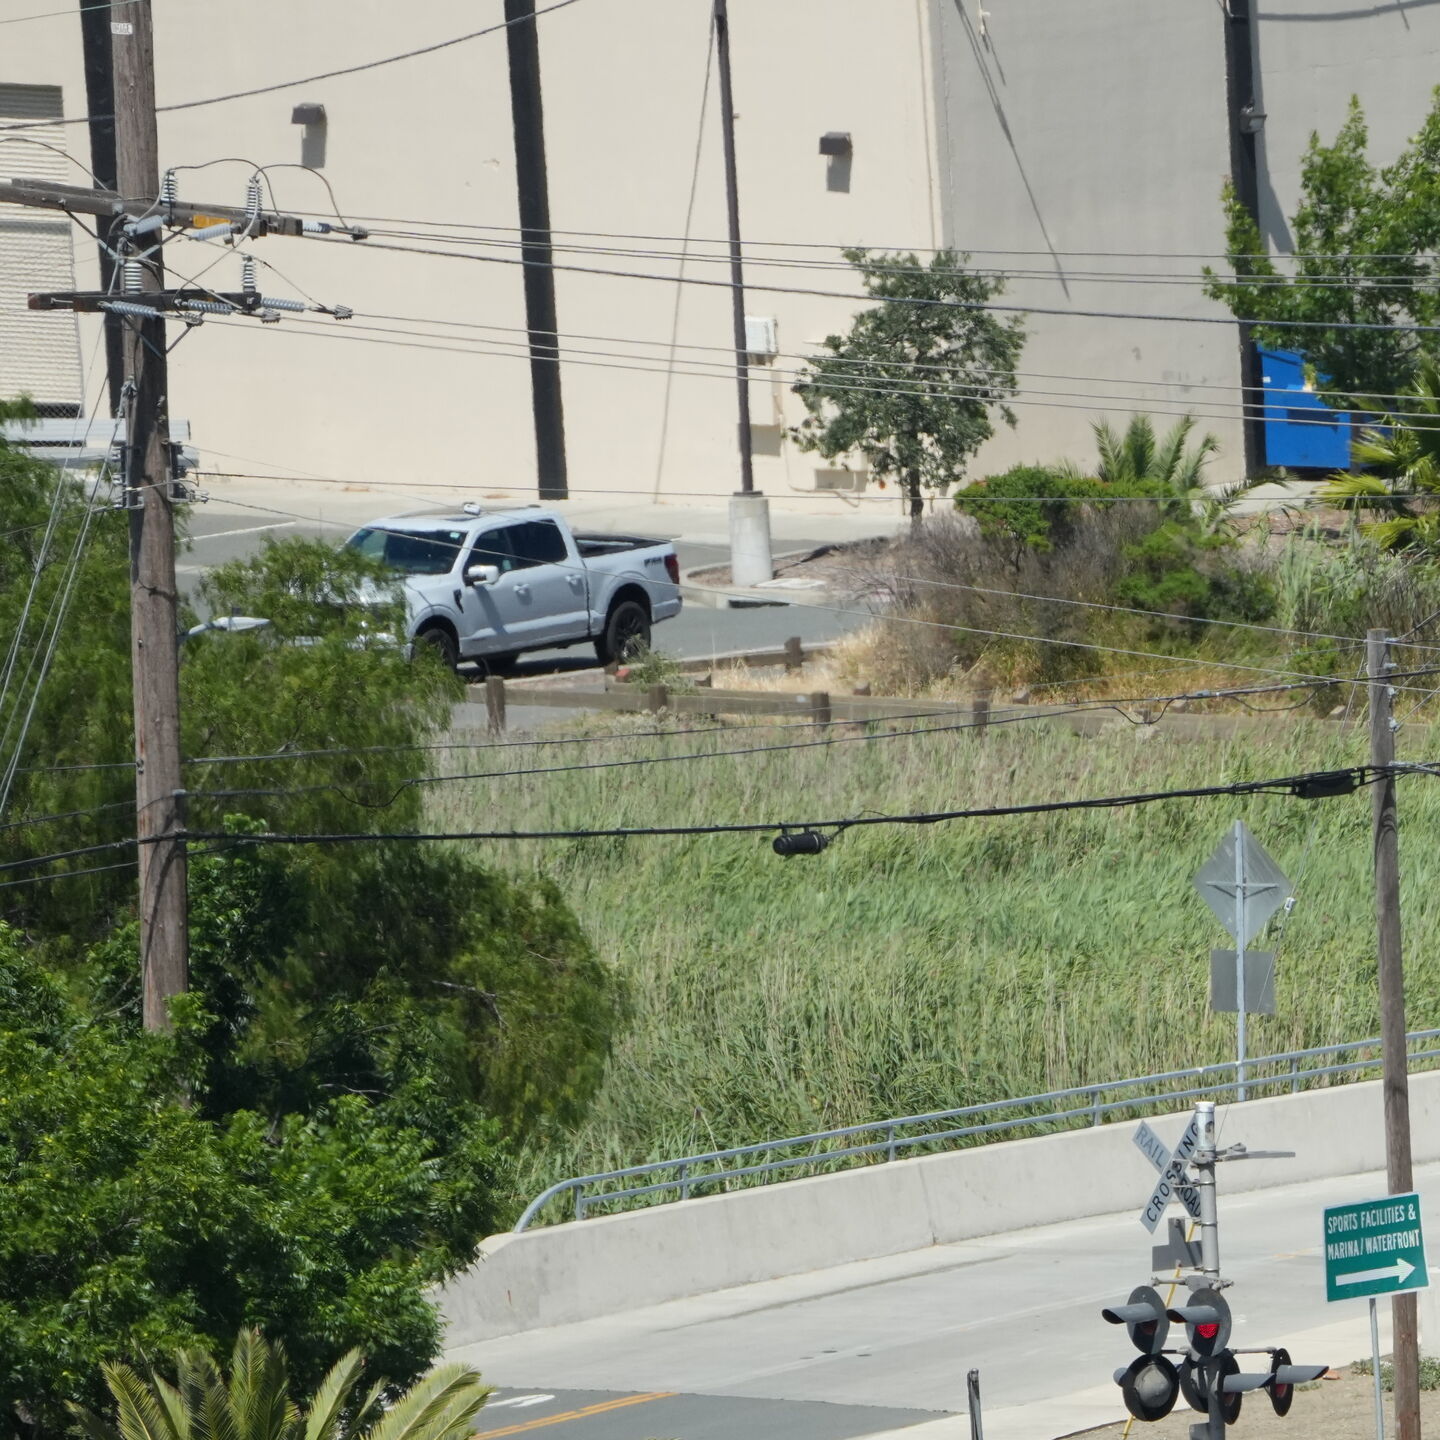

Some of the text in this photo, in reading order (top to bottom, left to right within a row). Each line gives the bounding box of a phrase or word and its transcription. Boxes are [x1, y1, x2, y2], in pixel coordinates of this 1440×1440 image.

[1136, 1124, 1165, 1169] RAIL
[1327, 1203, 1417, 1234] SPORTS FACILITIES &
